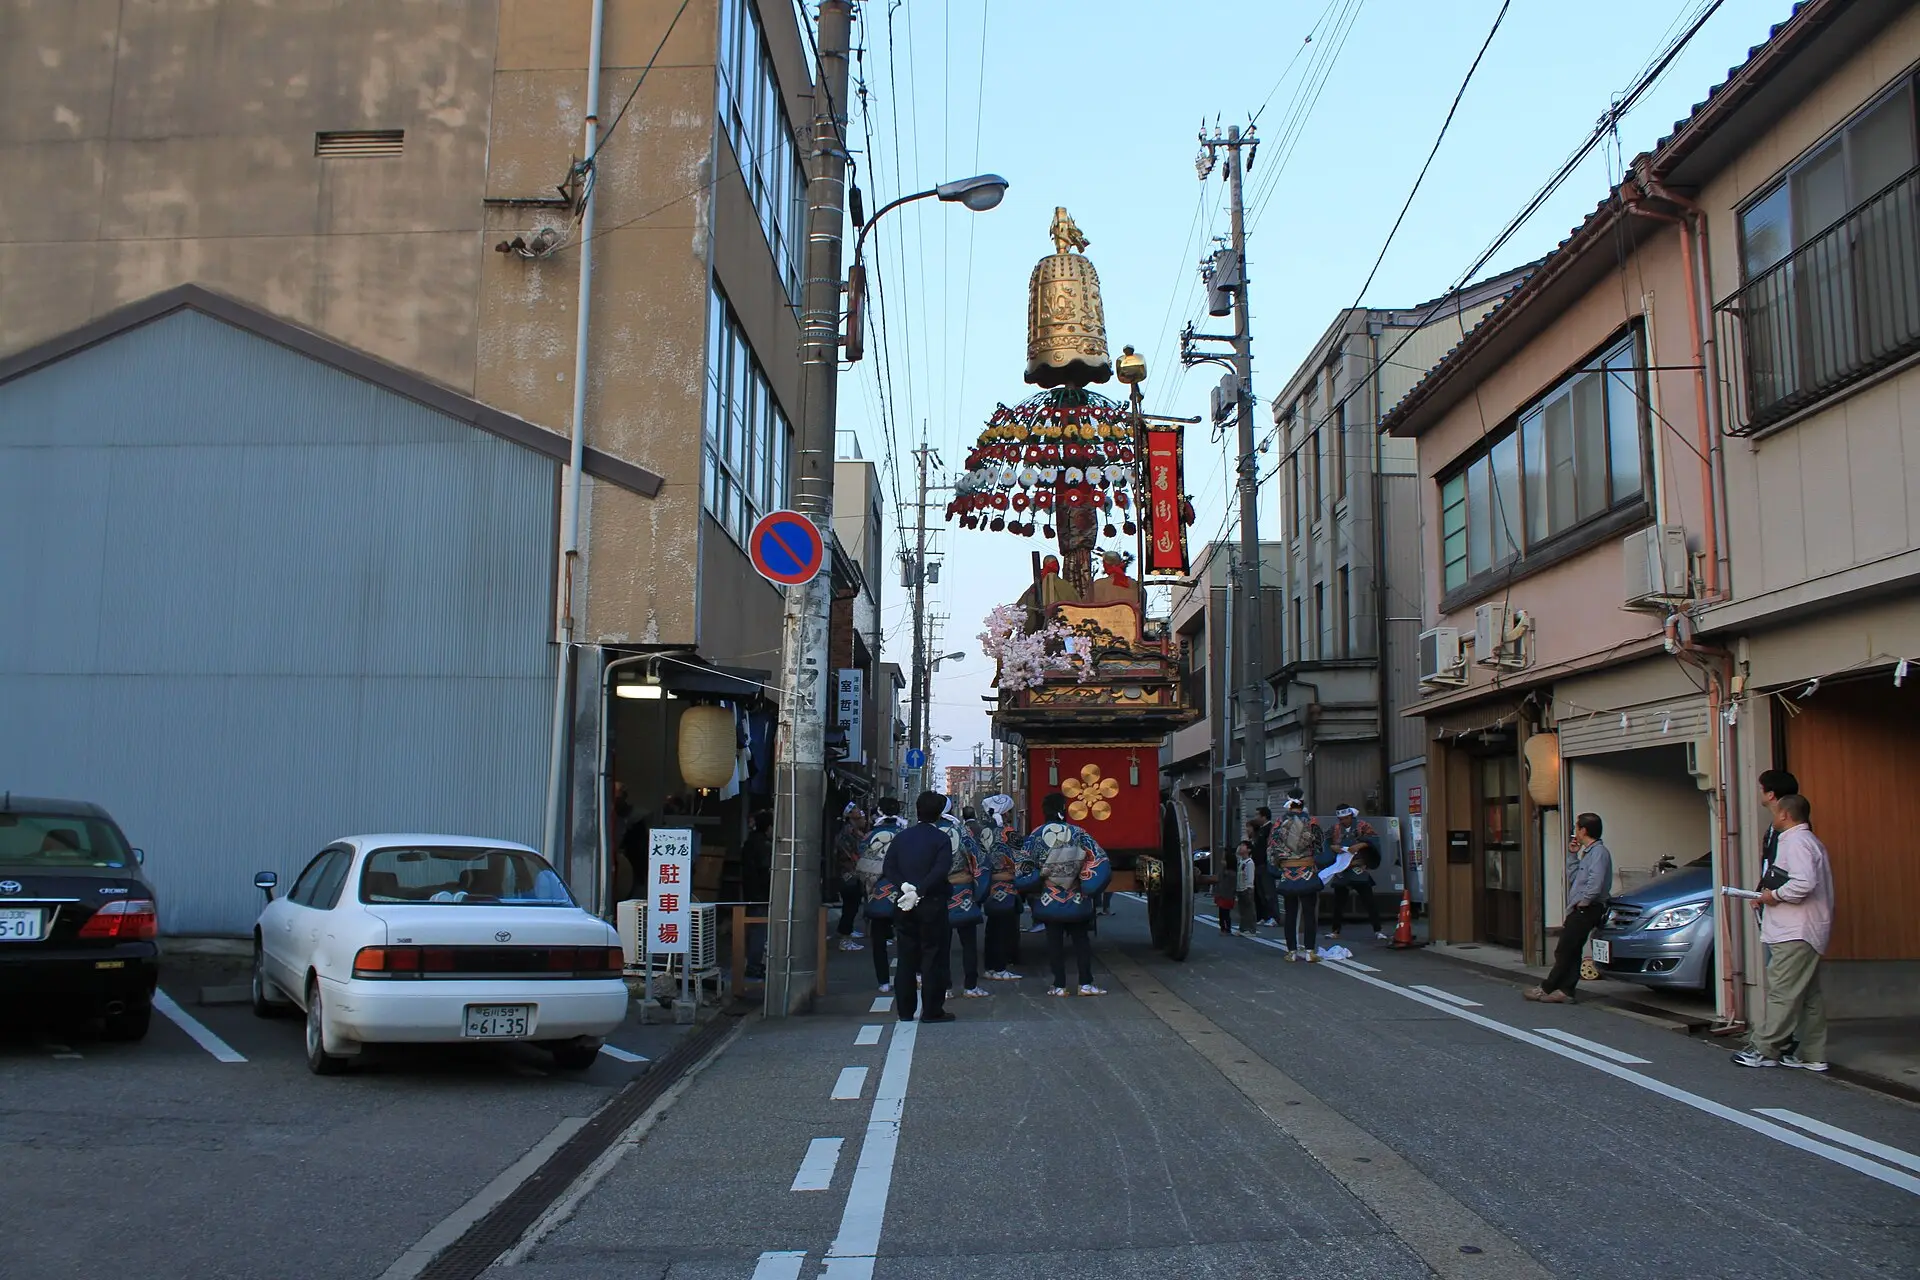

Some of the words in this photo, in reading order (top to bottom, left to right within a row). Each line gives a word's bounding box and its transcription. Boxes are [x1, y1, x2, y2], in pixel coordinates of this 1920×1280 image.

[658, 863, 680, 944] 駐車場
[480, 1018, 524, 1034] 61-35
